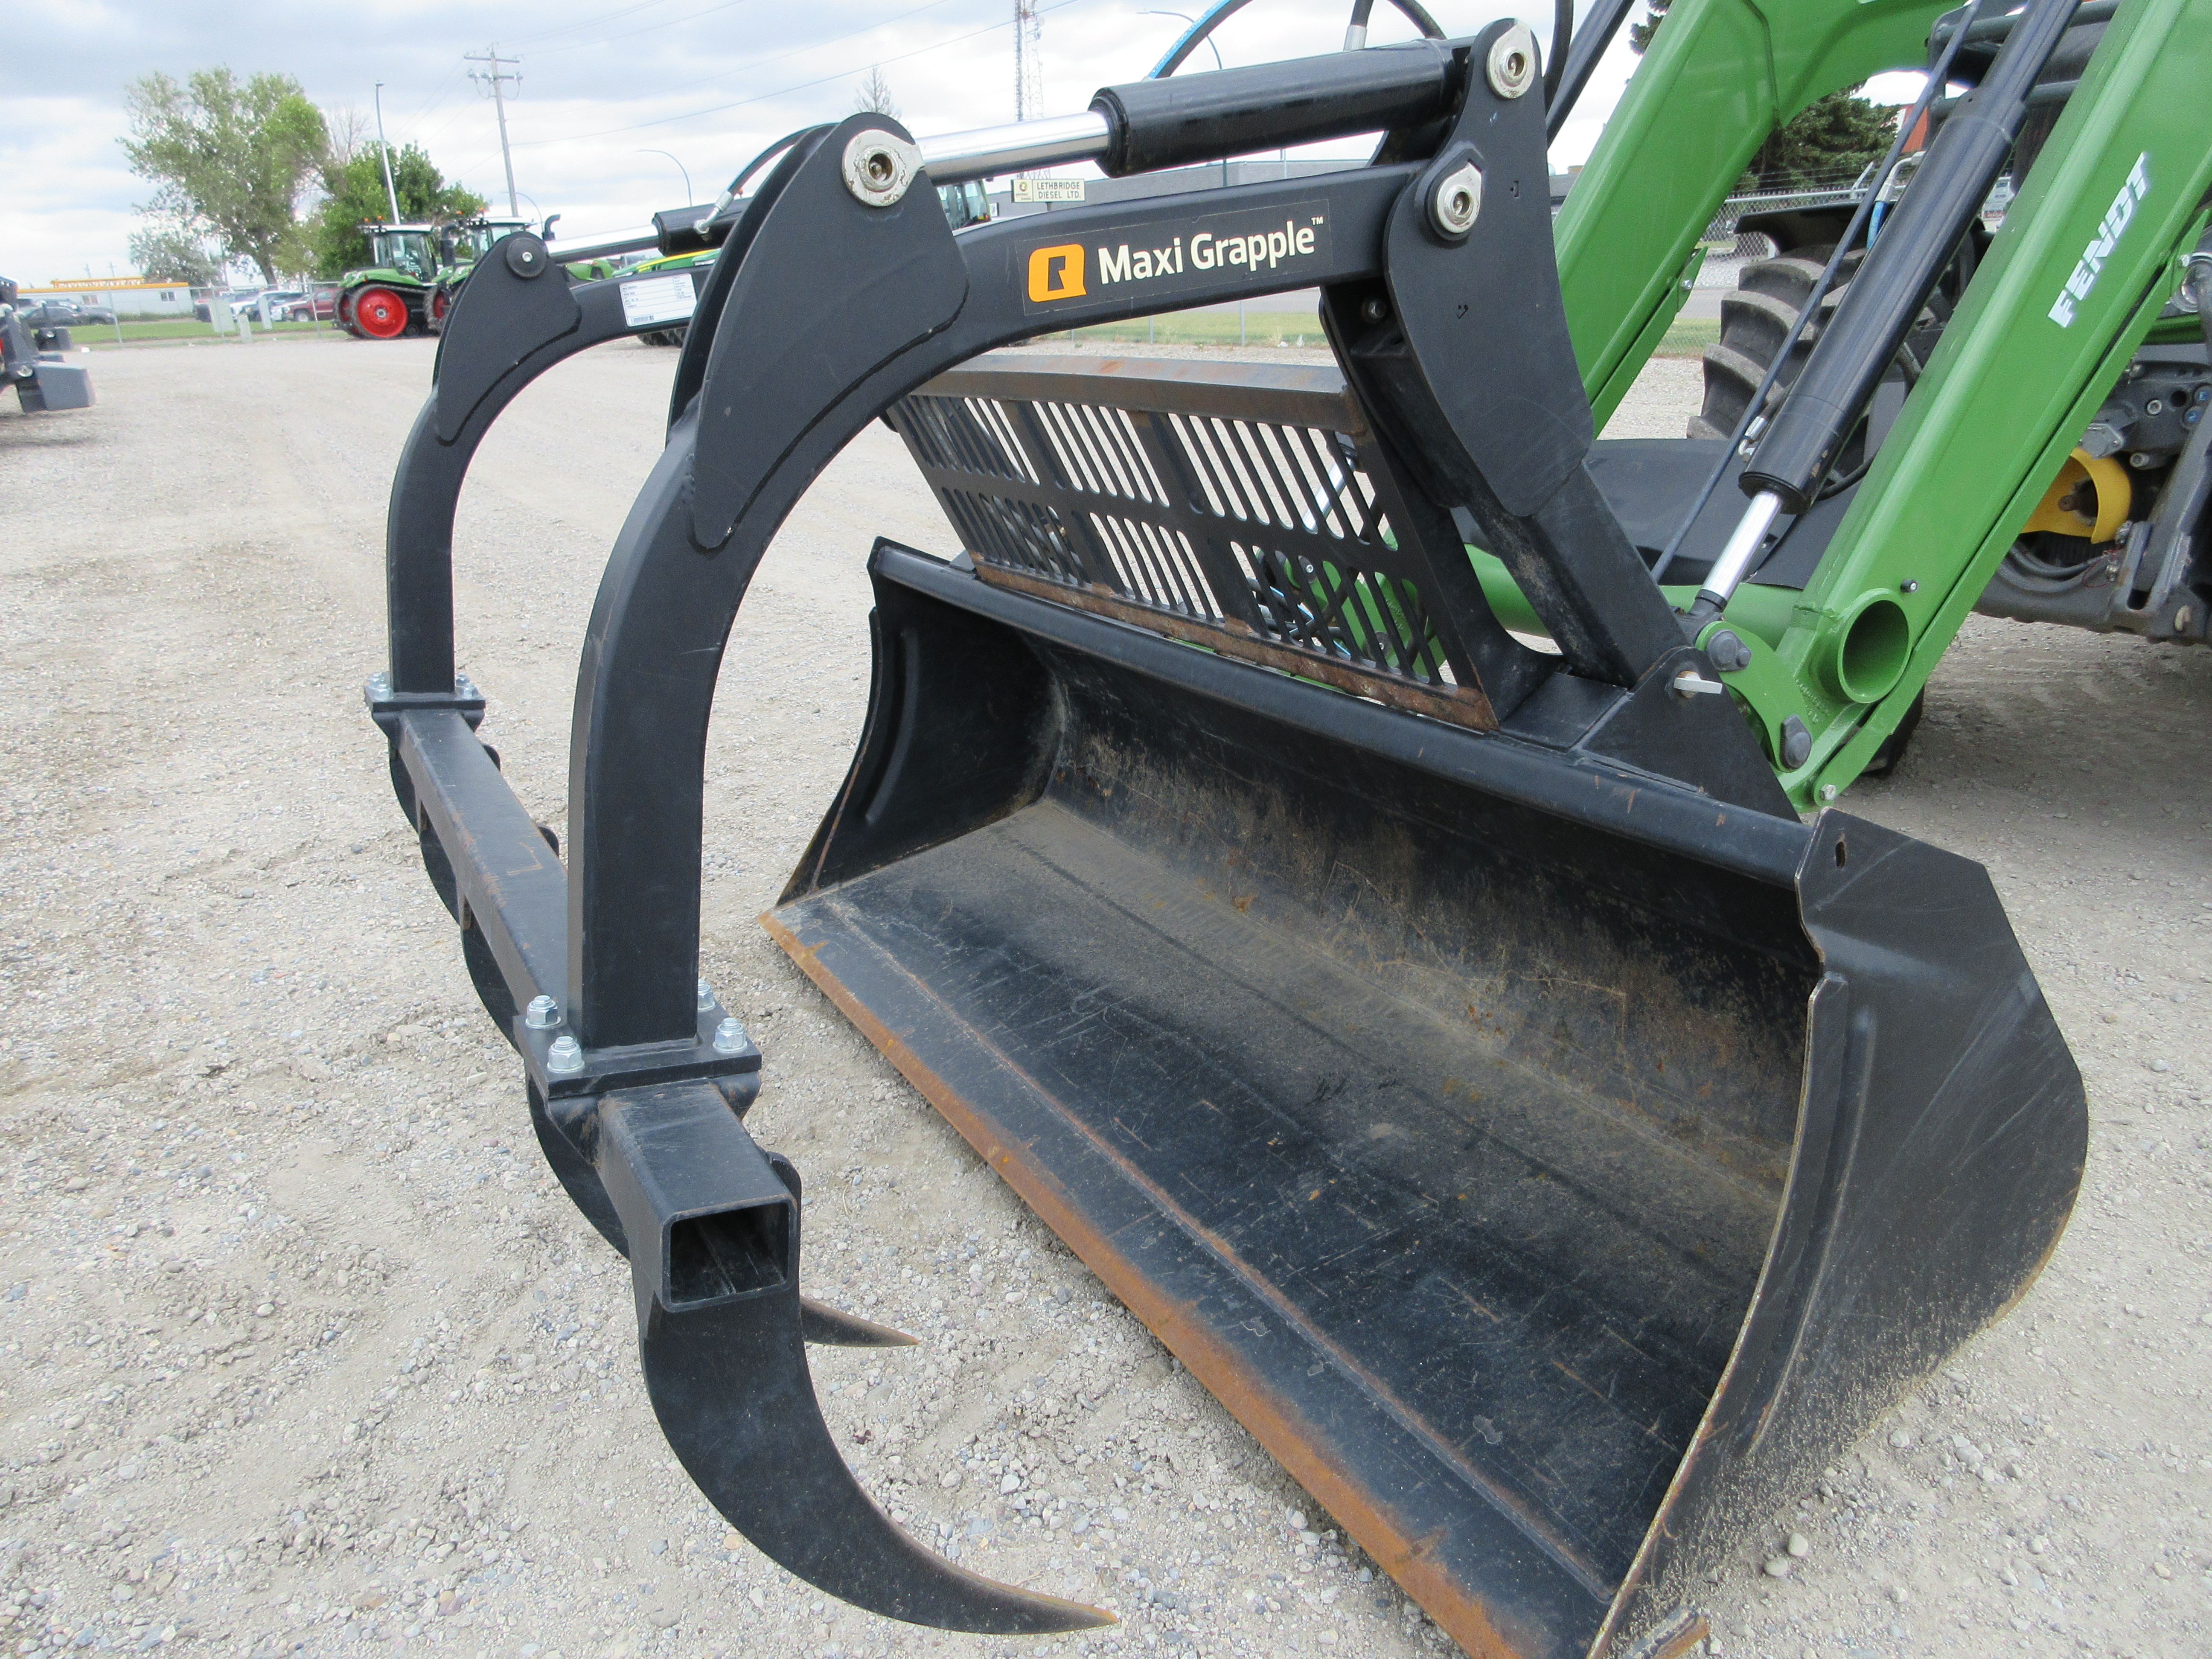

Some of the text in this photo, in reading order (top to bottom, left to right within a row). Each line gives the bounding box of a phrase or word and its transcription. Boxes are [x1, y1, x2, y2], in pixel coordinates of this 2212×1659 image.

[1036, 181, 1080, 190] LETHBRIDGE
[1038, 191, 1062, 199] DIESEL
[1067, 191, 1081, 199] LTD.
[2047, 151, 2149, 328] FENDT
[1097, 237, 1184, 285] Maxi
